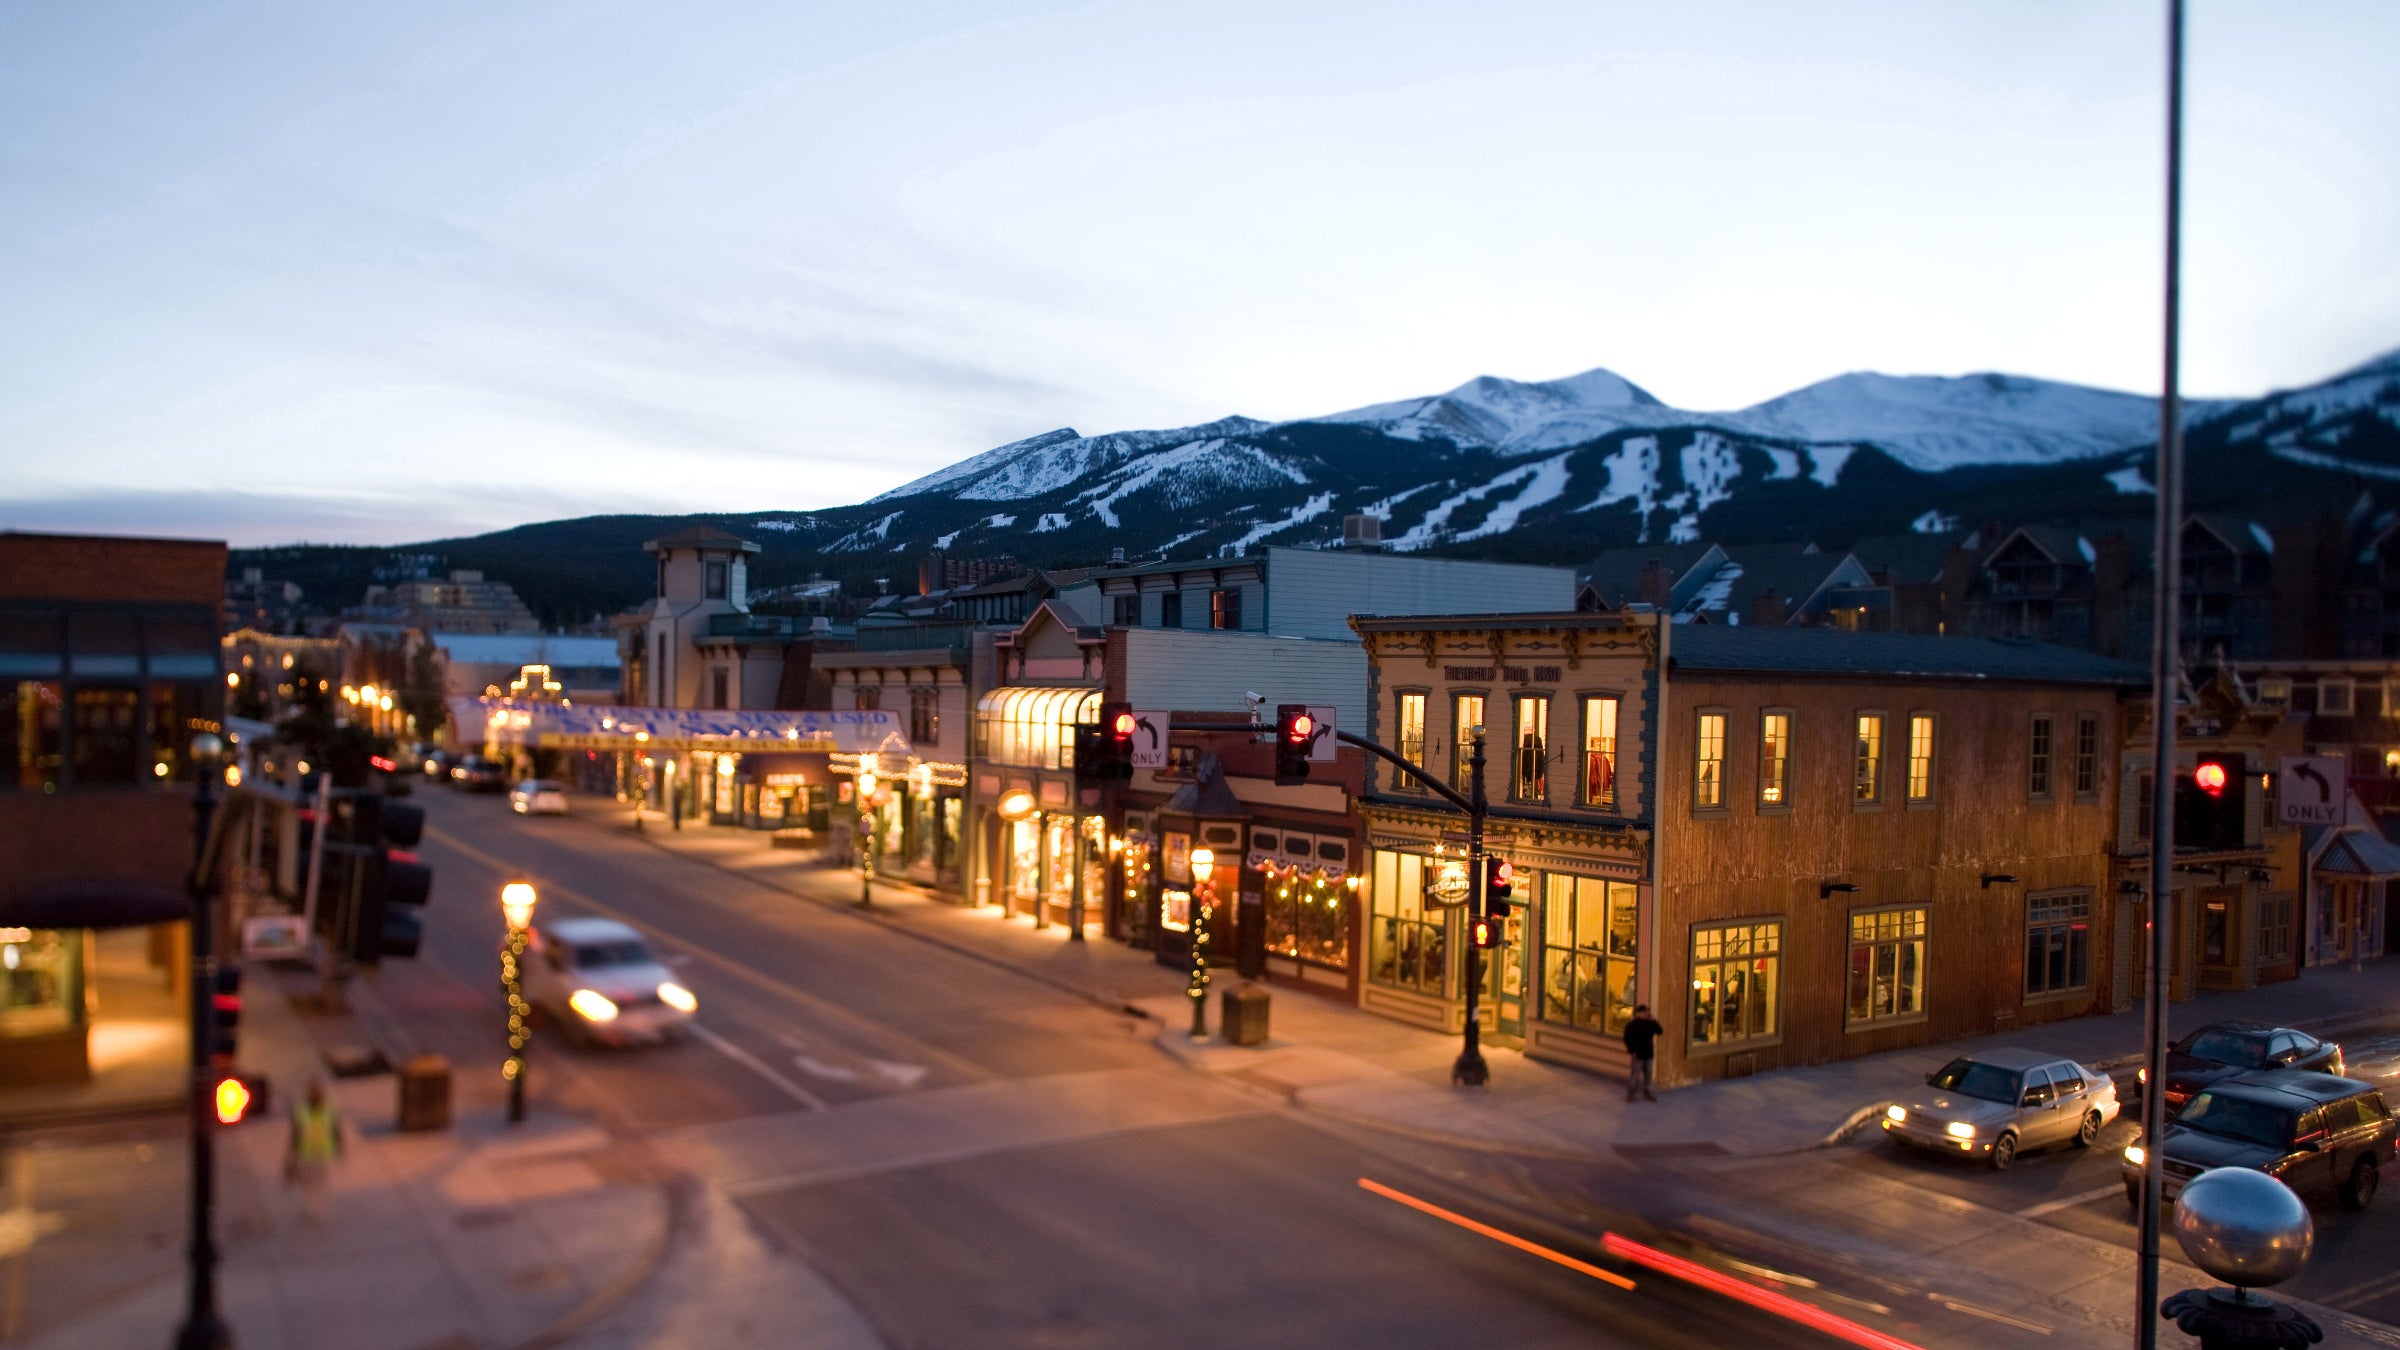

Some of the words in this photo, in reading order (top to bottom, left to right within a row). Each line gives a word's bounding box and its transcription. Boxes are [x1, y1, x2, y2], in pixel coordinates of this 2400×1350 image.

[736, 711, 792, 724] NEW
[802, 711, 822, 724] &
[829, 711, 889, 724] USED
[1131, 752, 1162, 764] ONLY
[2286, 804, 2336, 821] ONLY
[1428, 877, 1470, 894] MERCANTI
